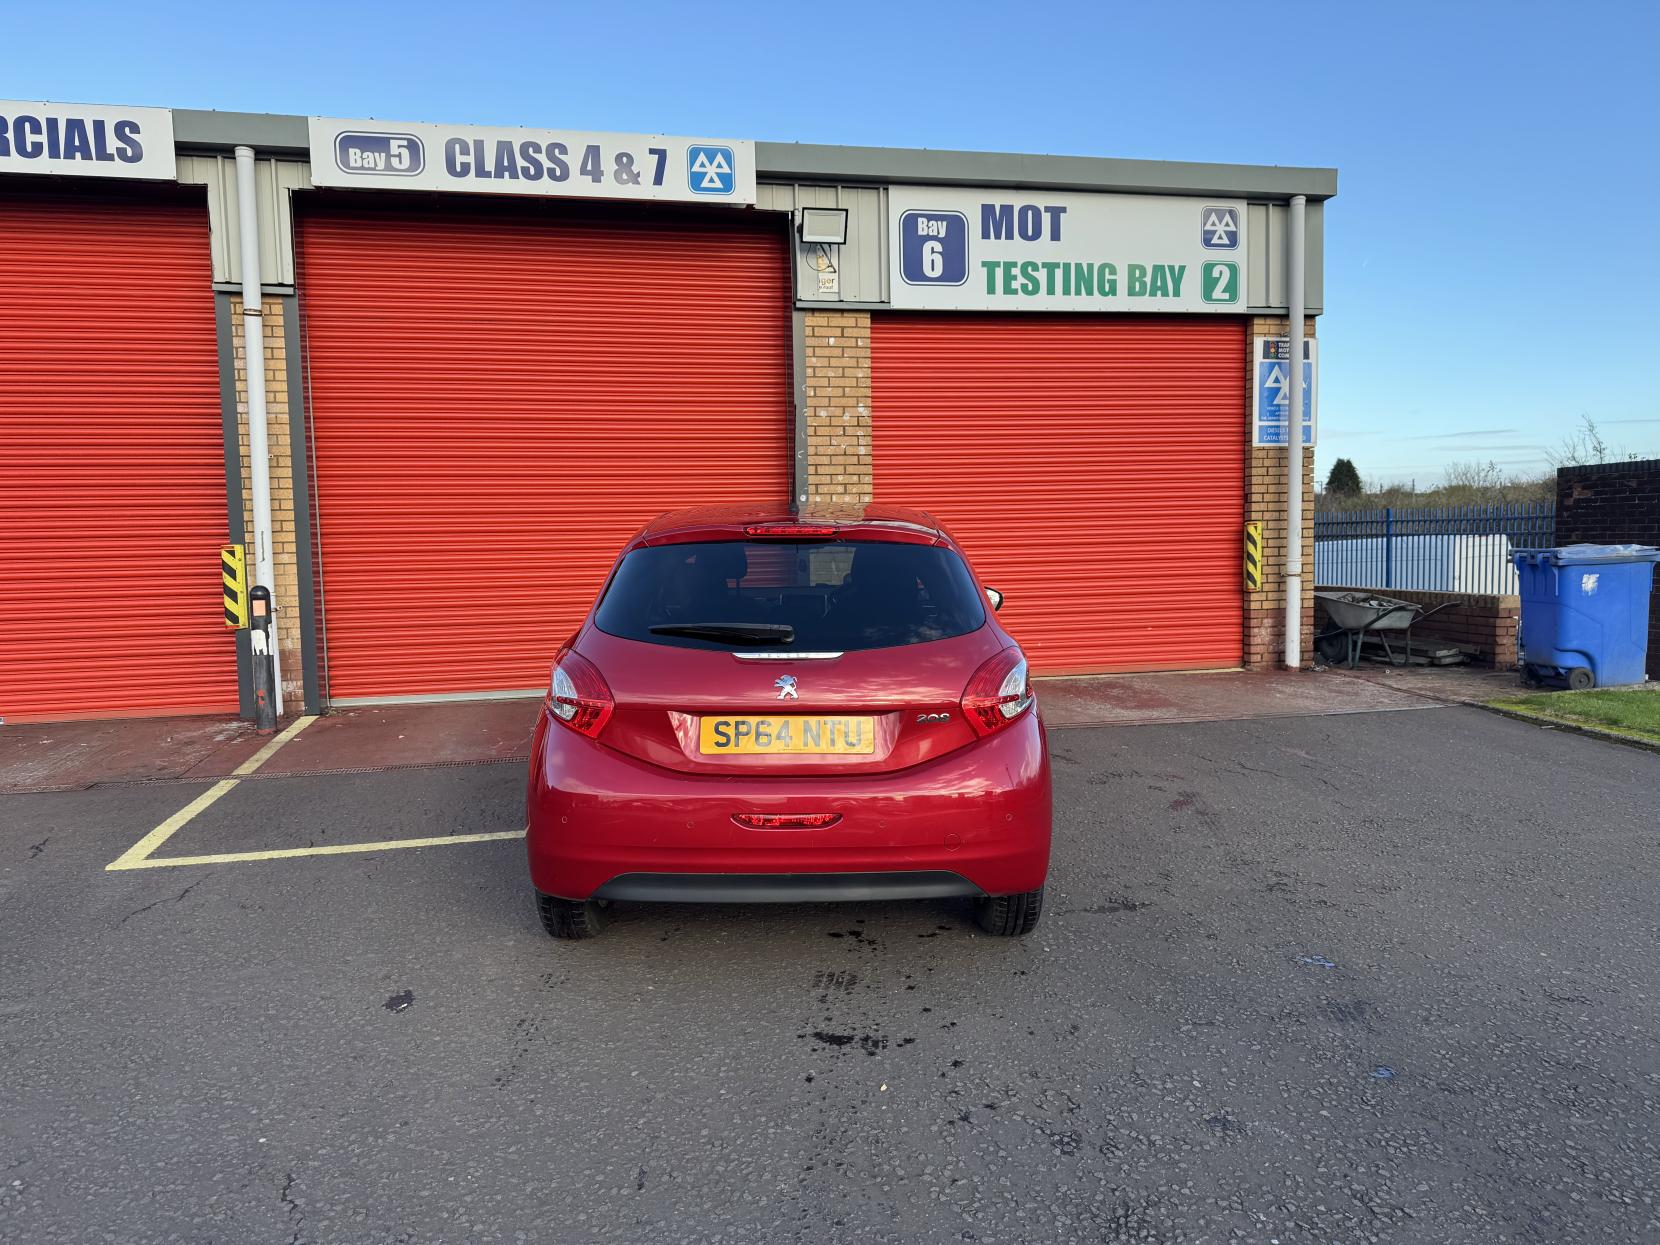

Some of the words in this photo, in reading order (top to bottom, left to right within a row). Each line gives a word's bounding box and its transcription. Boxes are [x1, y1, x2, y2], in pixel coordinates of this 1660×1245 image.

[349, 148, 387, 171] Bay
[390, 139, 411, 170] 5
[444, 137, 570, 183] CLASS
[580, 145, 602, 184] 4
[613, 151, 641, 186] &
[648, 147, 667, 187] 7
[917, 217, 947, 238] Bay
[980, 203, 1067, 242] MOT
[922, 240, 944, 278] 6
[981, 260, 1118, 297] TESTING
[1127, 263, 1187, 298] BAY
[1211, 264, 1231, 300] 2
[713, 720, 793, 748] SP64
[802, 719, 862, 748] NTU
[916, 712, 950, 723] 208
